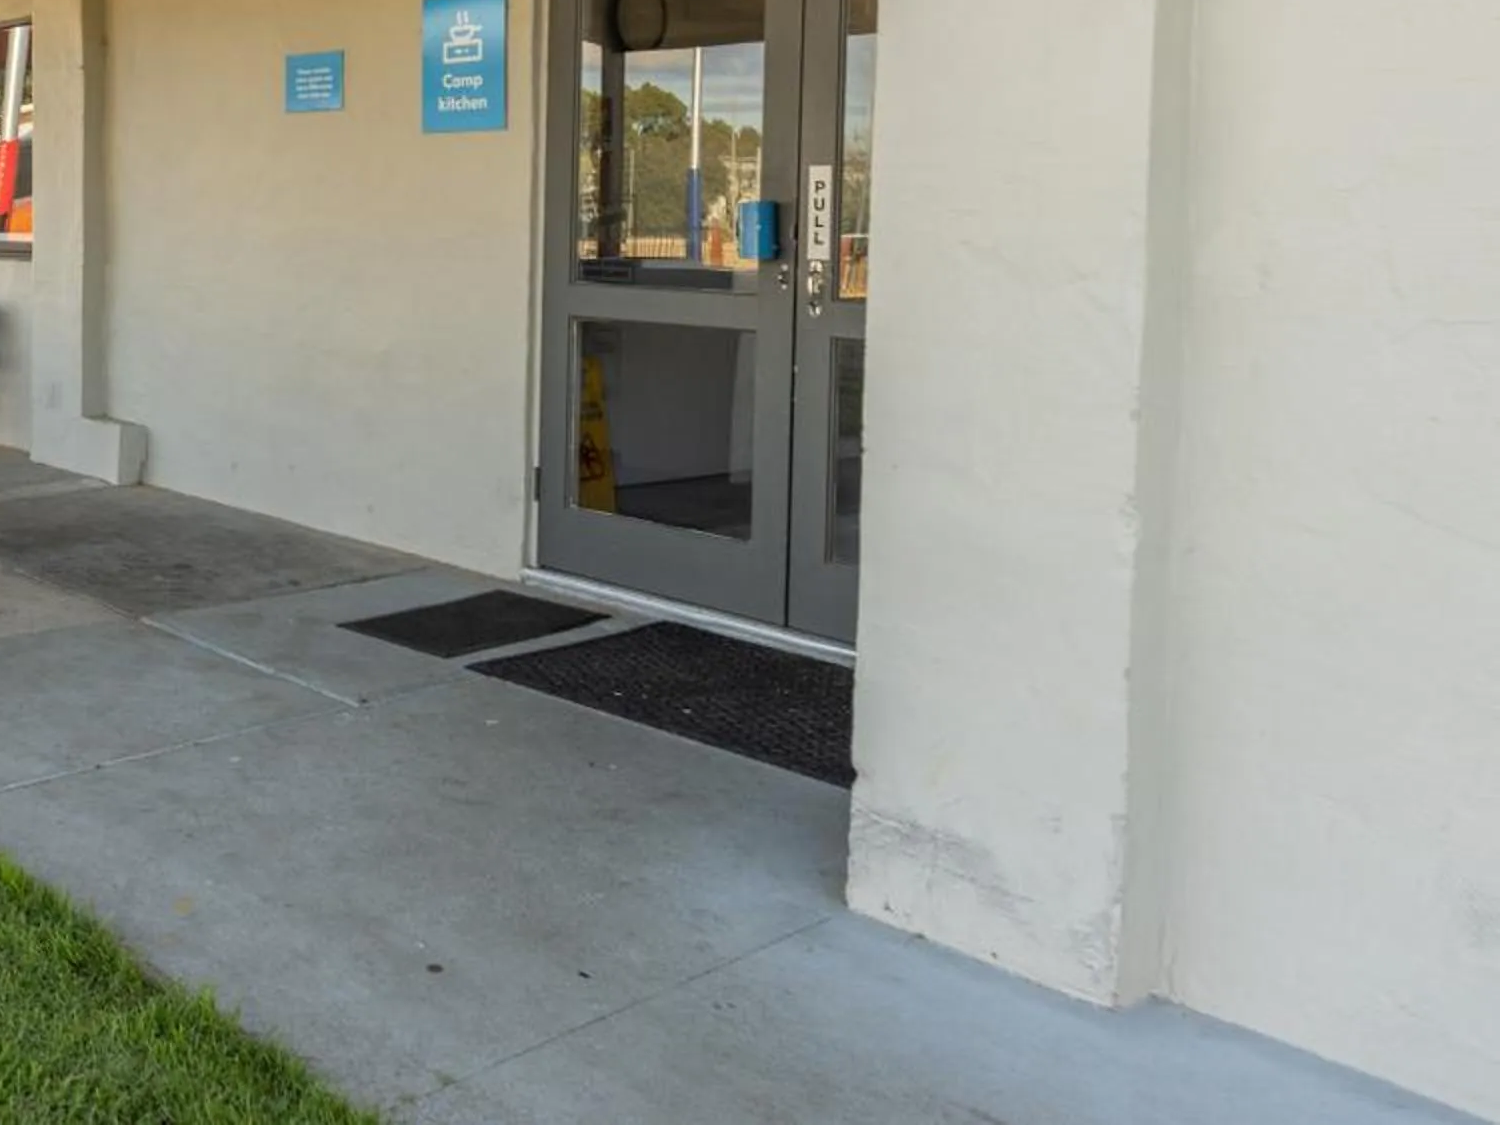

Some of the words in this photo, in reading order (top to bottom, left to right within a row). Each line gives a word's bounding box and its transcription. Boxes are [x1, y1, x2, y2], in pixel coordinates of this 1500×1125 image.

[442, 74, 484, 89] Camp
[438, 96, 487, 111] kitchen
[813, 180, 826, 246] PULL
